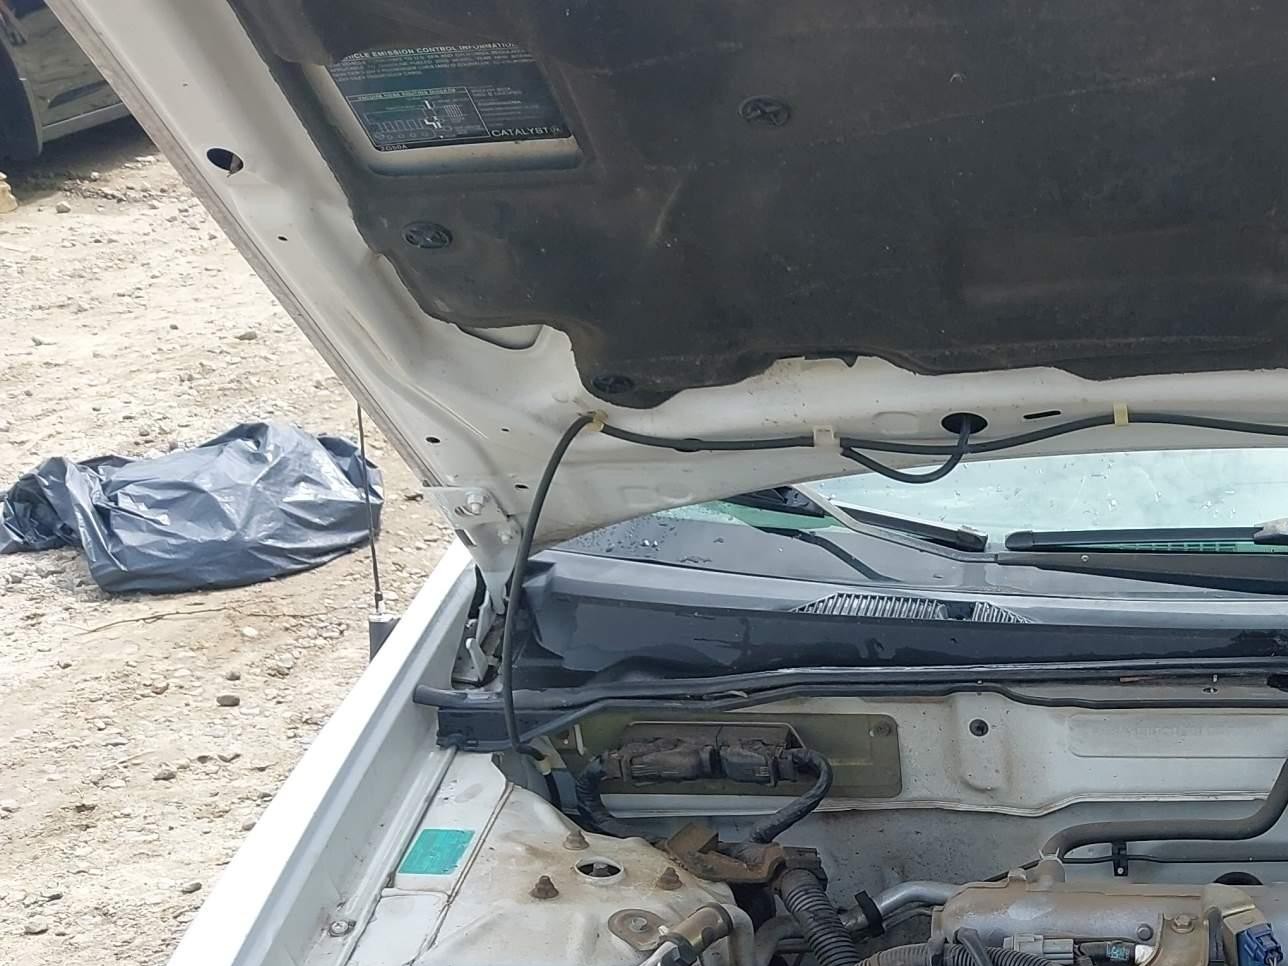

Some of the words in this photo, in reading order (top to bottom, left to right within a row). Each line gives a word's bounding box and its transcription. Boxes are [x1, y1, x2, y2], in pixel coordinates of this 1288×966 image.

[371, 48, 415, 57] EMISSION
[416, 45, 457, 54] CONTROL
[491, 127, 549, 137] CATALYST
